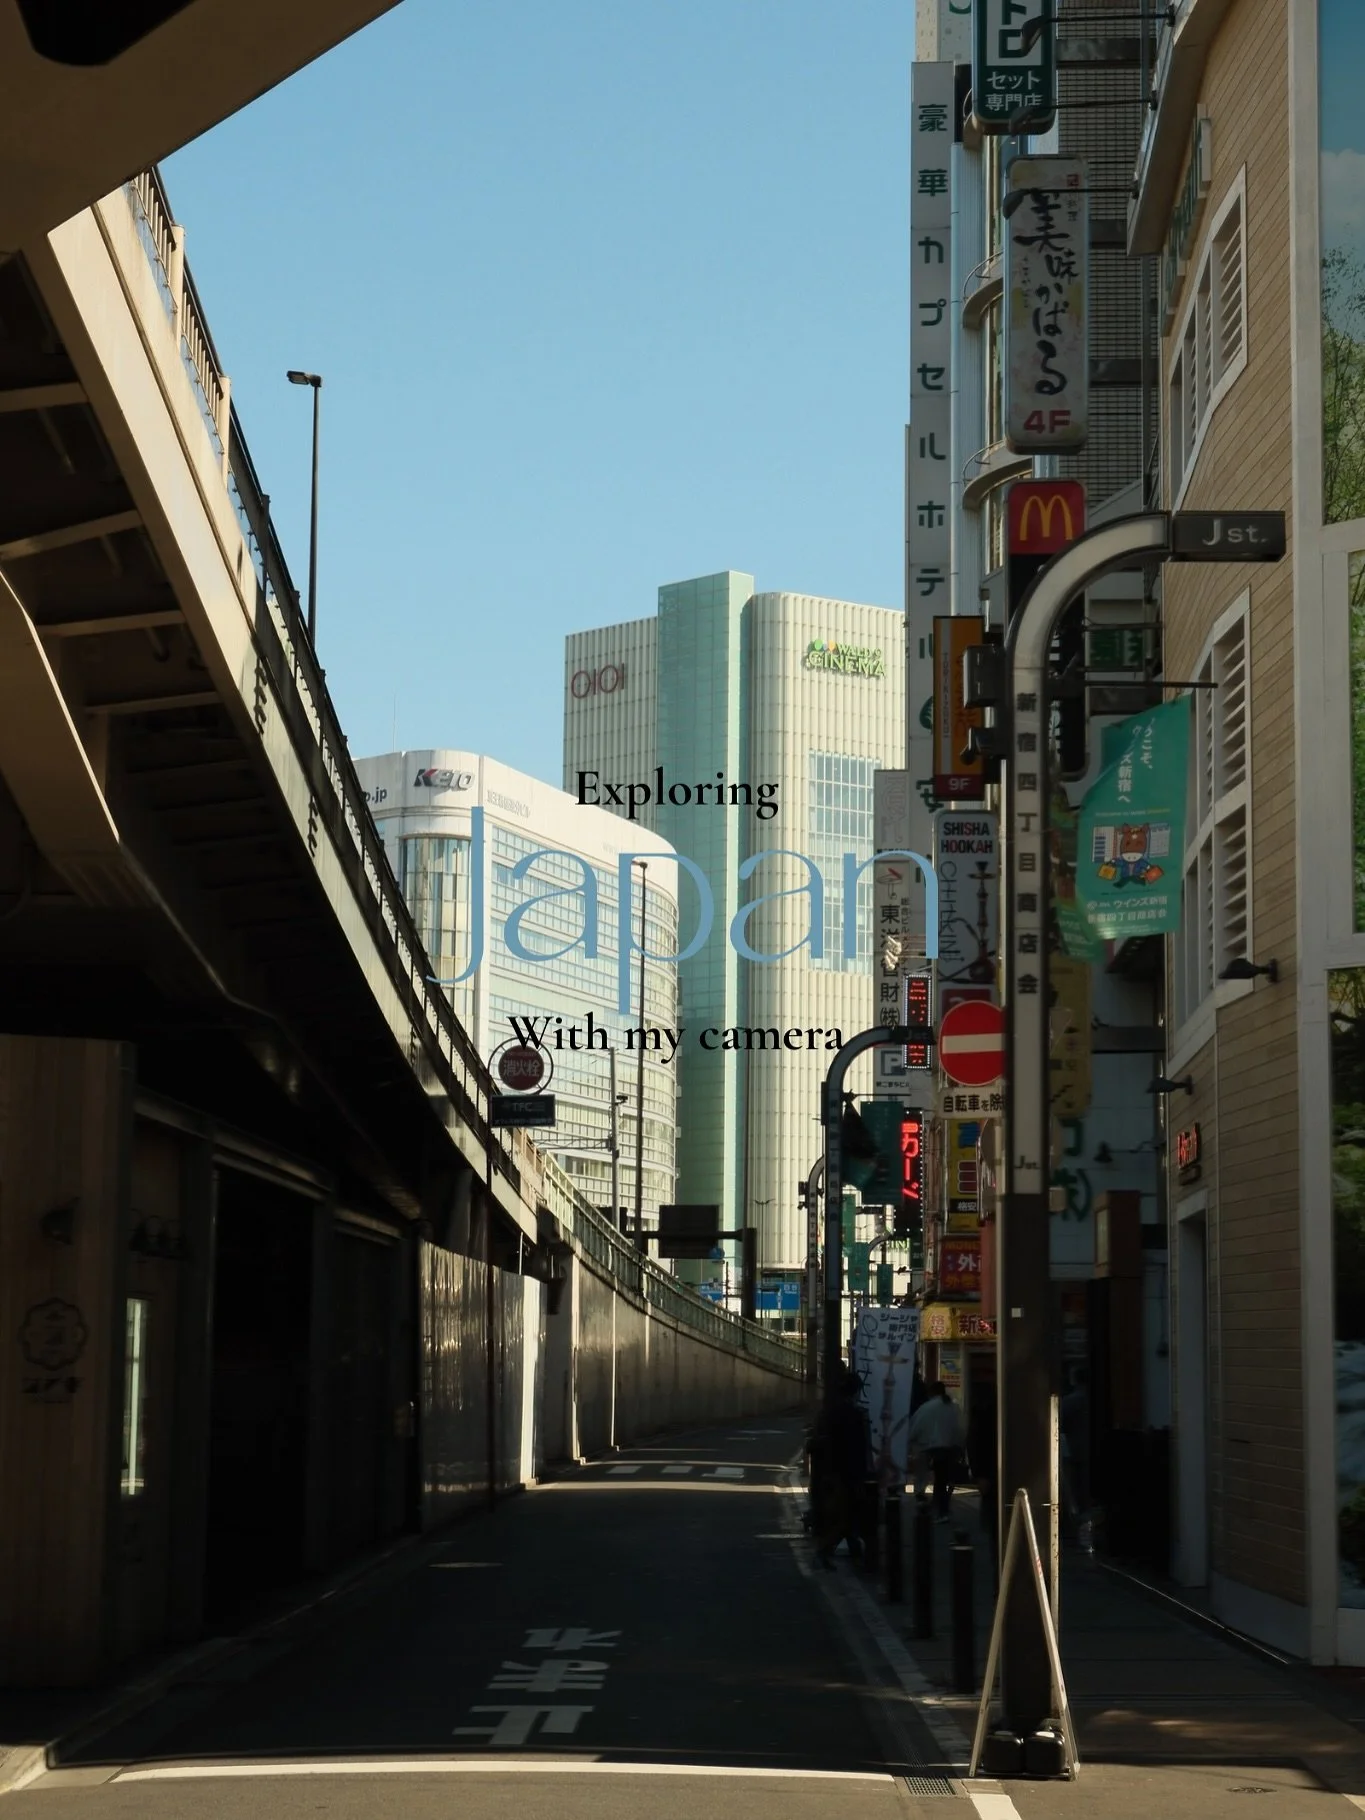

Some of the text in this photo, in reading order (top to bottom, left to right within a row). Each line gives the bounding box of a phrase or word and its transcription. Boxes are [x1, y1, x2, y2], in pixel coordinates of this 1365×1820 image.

[986, 71, 1041, 91] セット
[985, 93, 1044, 111] 専門店
[1023, 410, 1071, 434] 4F
[808, 651, 886, 677] CINEMA
[949, 778, 970, 791] 9F
[943, 822, 990, 836] SHISHA
[941, 840, 993, 854] HOOKAH
[1017, 692, 1038, 996] 新宿四丁目商店会
[503, 1059, 541, 1077] 消火栓
[943, 1093, 1004, 1112] 自転車を除
[958, 1253, 981, 1273] 外
